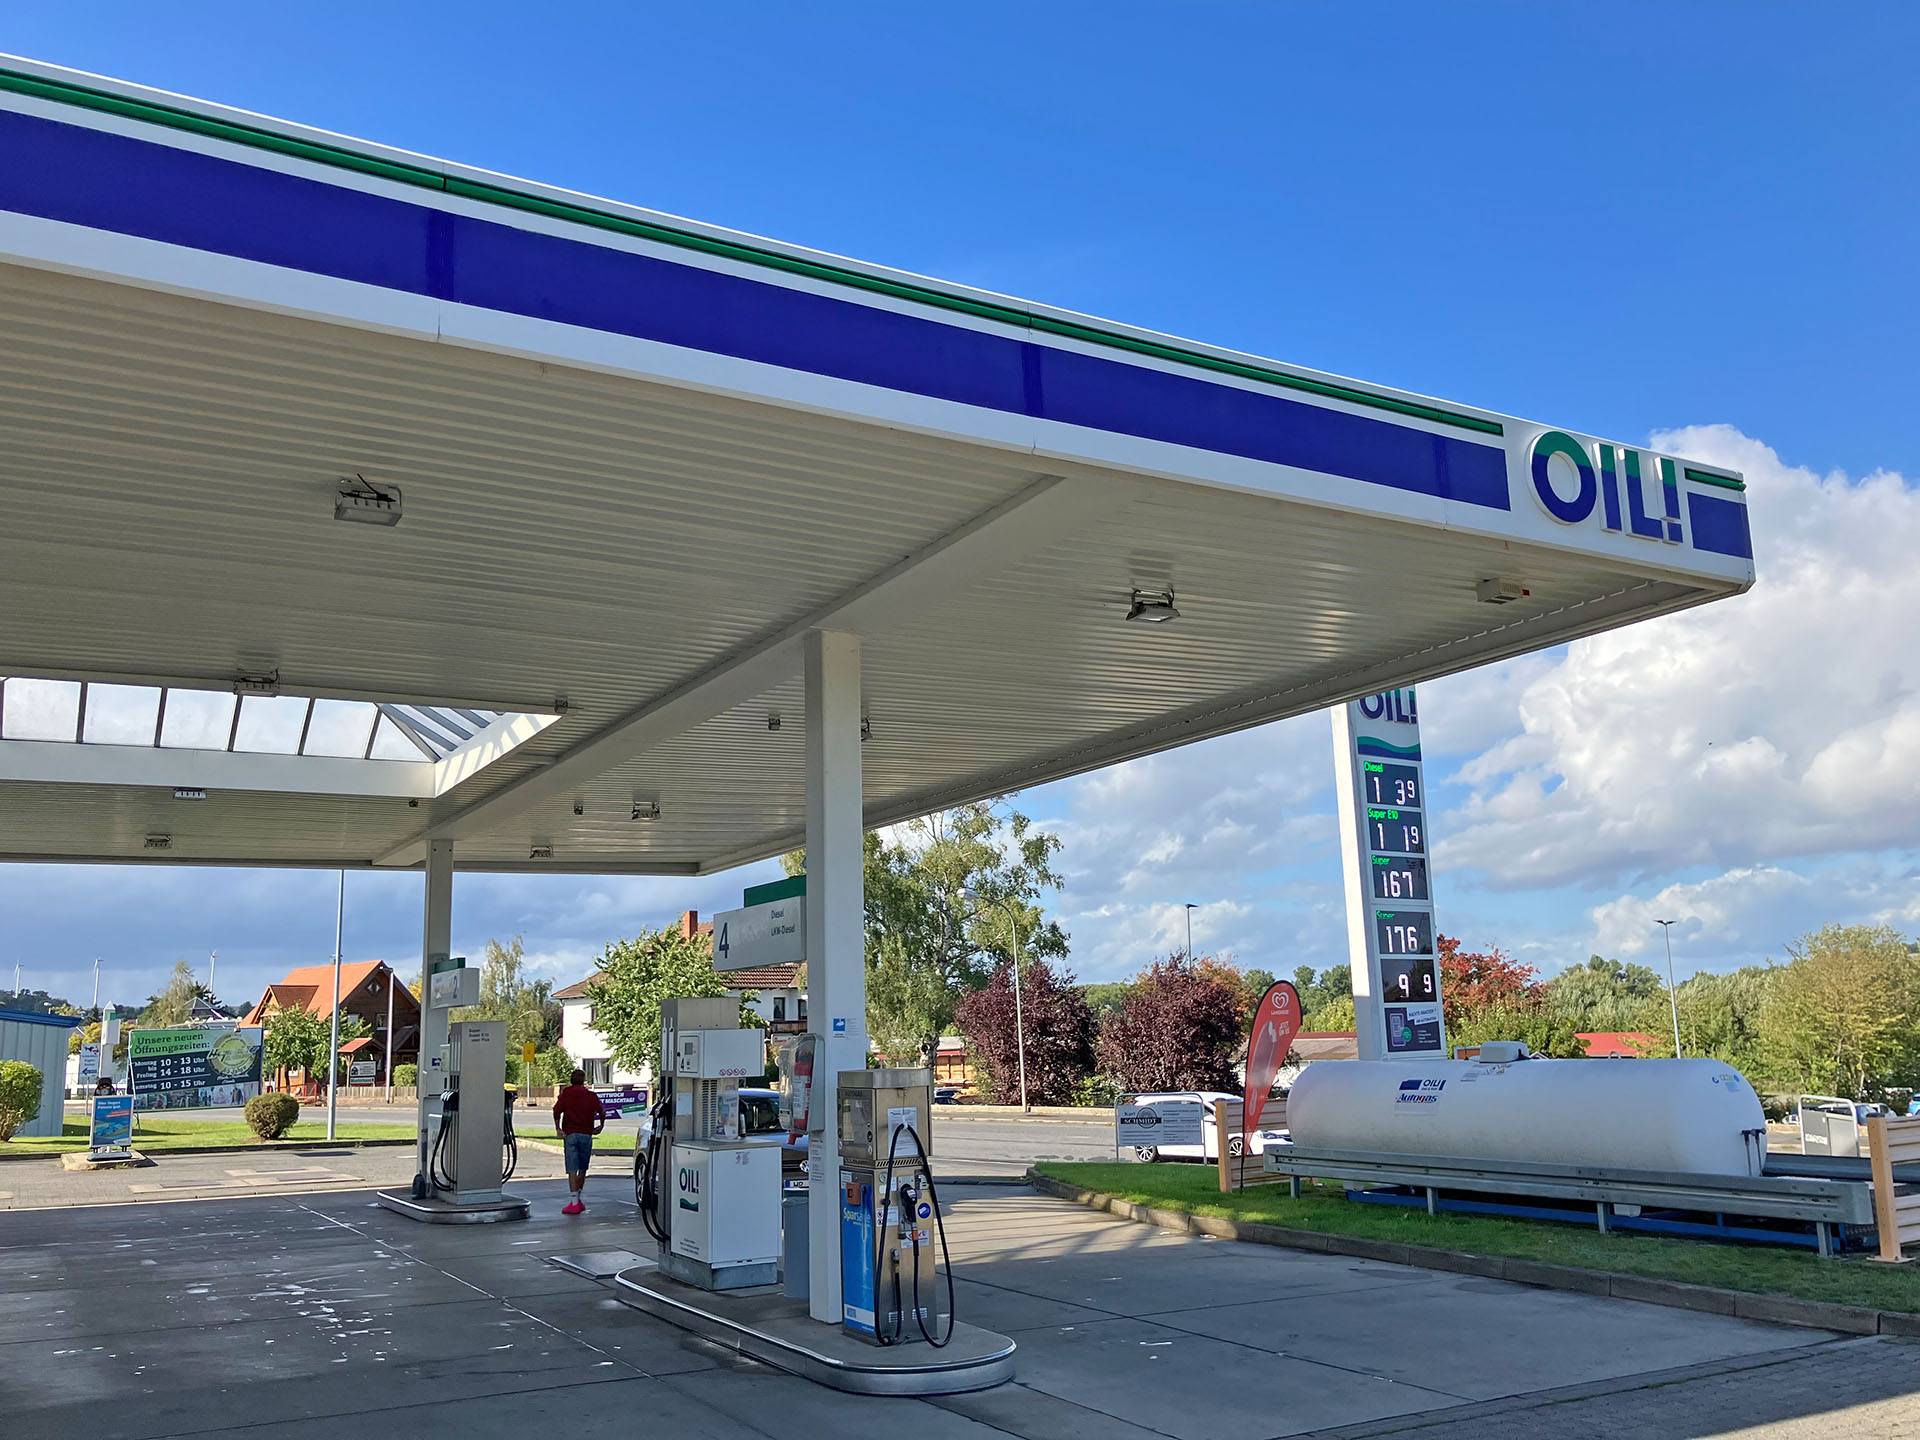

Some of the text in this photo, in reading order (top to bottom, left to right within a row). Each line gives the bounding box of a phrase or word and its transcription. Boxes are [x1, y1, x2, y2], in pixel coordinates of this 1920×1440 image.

[1530, 431, 1683, 544] OIL!
[1360, 690, 1417, 724] OIL!
[1364, 761, 1383, 773] Diesel
[1368, 808, 1399, 820] Super E10
[1371, 855, 1391, 866] Super
[1381, 870, 1413, 898] 167
[771, 908, 785, 919] Diesel
[771, 923, 796, 936] LKW-Diesel
[719, 922, 730, 959] 4
[1386, 925, 1418, 953] 176
[137, 1033, 204, 1045] Unsere neuen
[134, 1041, 211, 1054] Öffnungszeiten:
[160, 1058, 171, 1067] 10
[180, 1056, 191, 1065] 13
[160, 1068, 171, 1077] 14
[181, 1066, 192, 1074] 18
[160, 1081, 171, 1090] 10
[181, 1080, 191, 1088] 15
[1397, 1093, 1438, 1103] Autogas
[679, 1167, 699, 1194] OIL!
